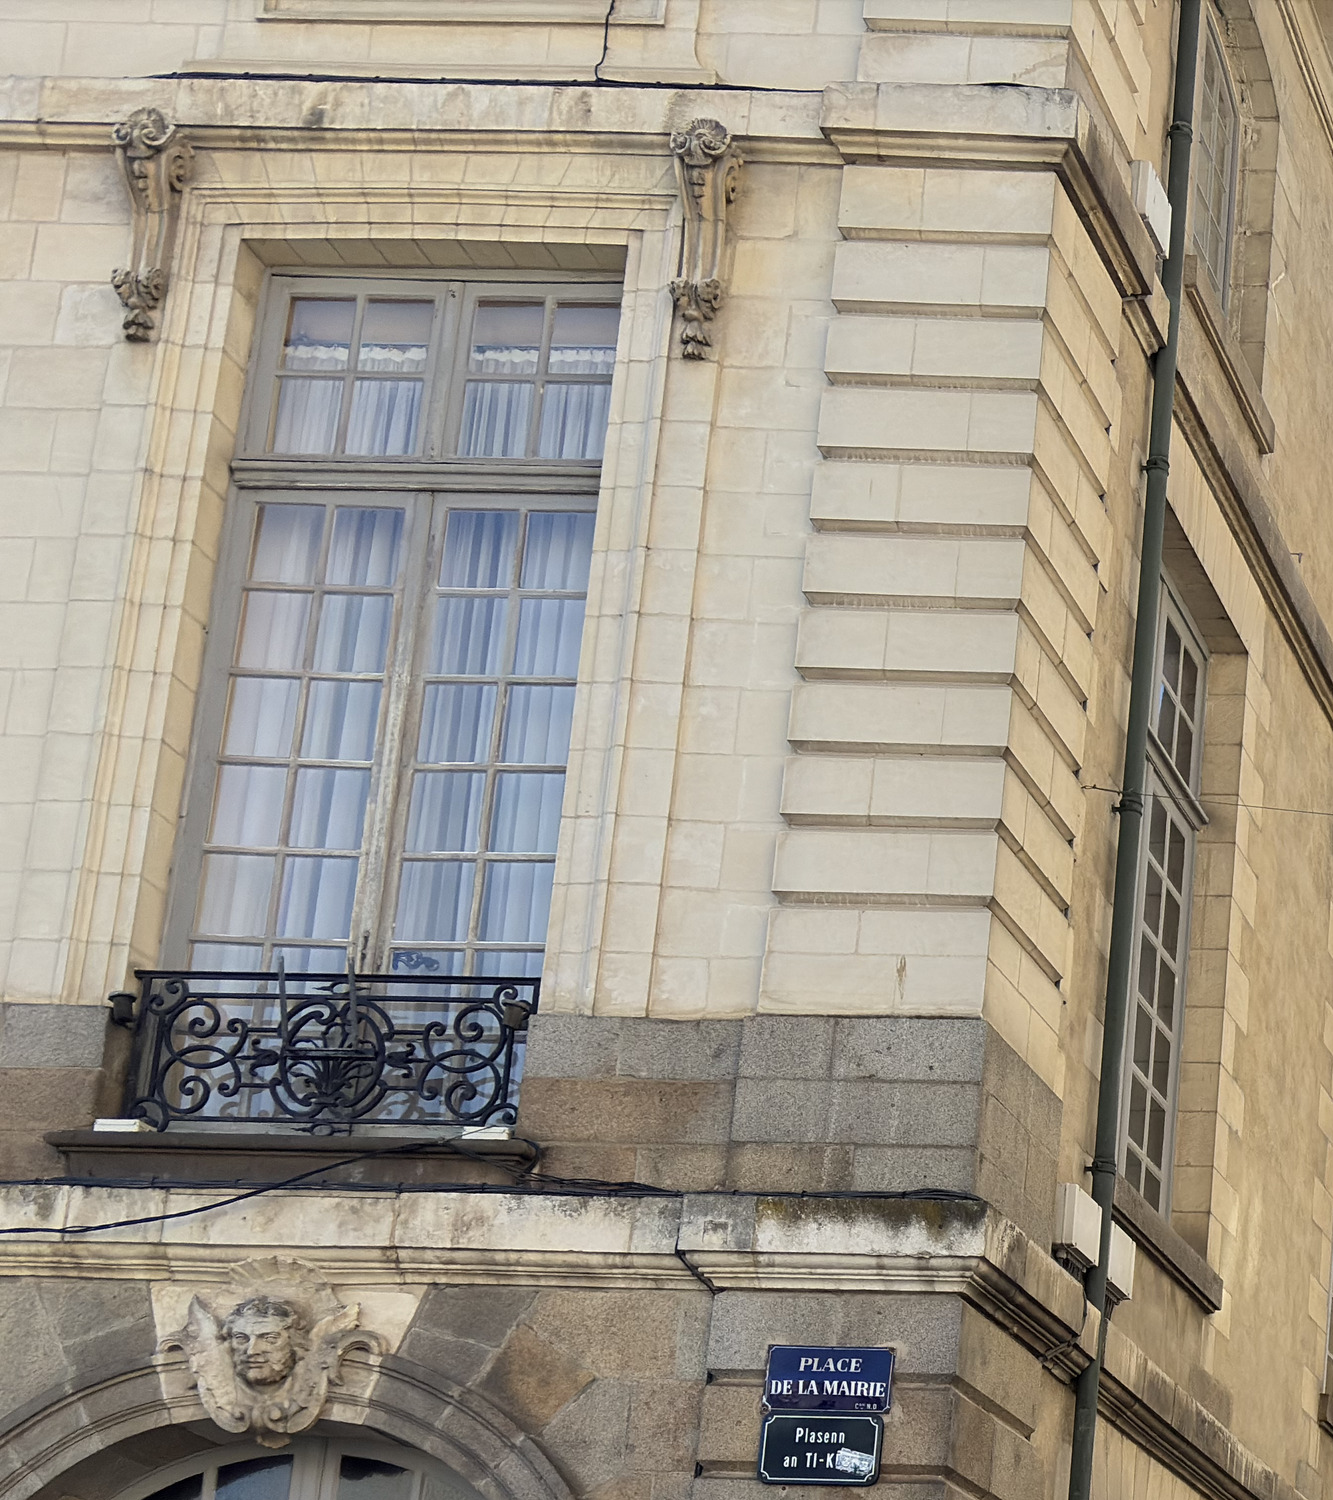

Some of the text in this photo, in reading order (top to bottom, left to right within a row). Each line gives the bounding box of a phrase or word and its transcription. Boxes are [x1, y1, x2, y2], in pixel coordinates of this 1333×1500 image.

[798, 1357, 863, 1373] PLACE
[770, 1380, 886, 1397] DE LA MAIRIE
[795, 1427, 845, 1444] Plasenn
[783, 1455, 797, 1468] an
